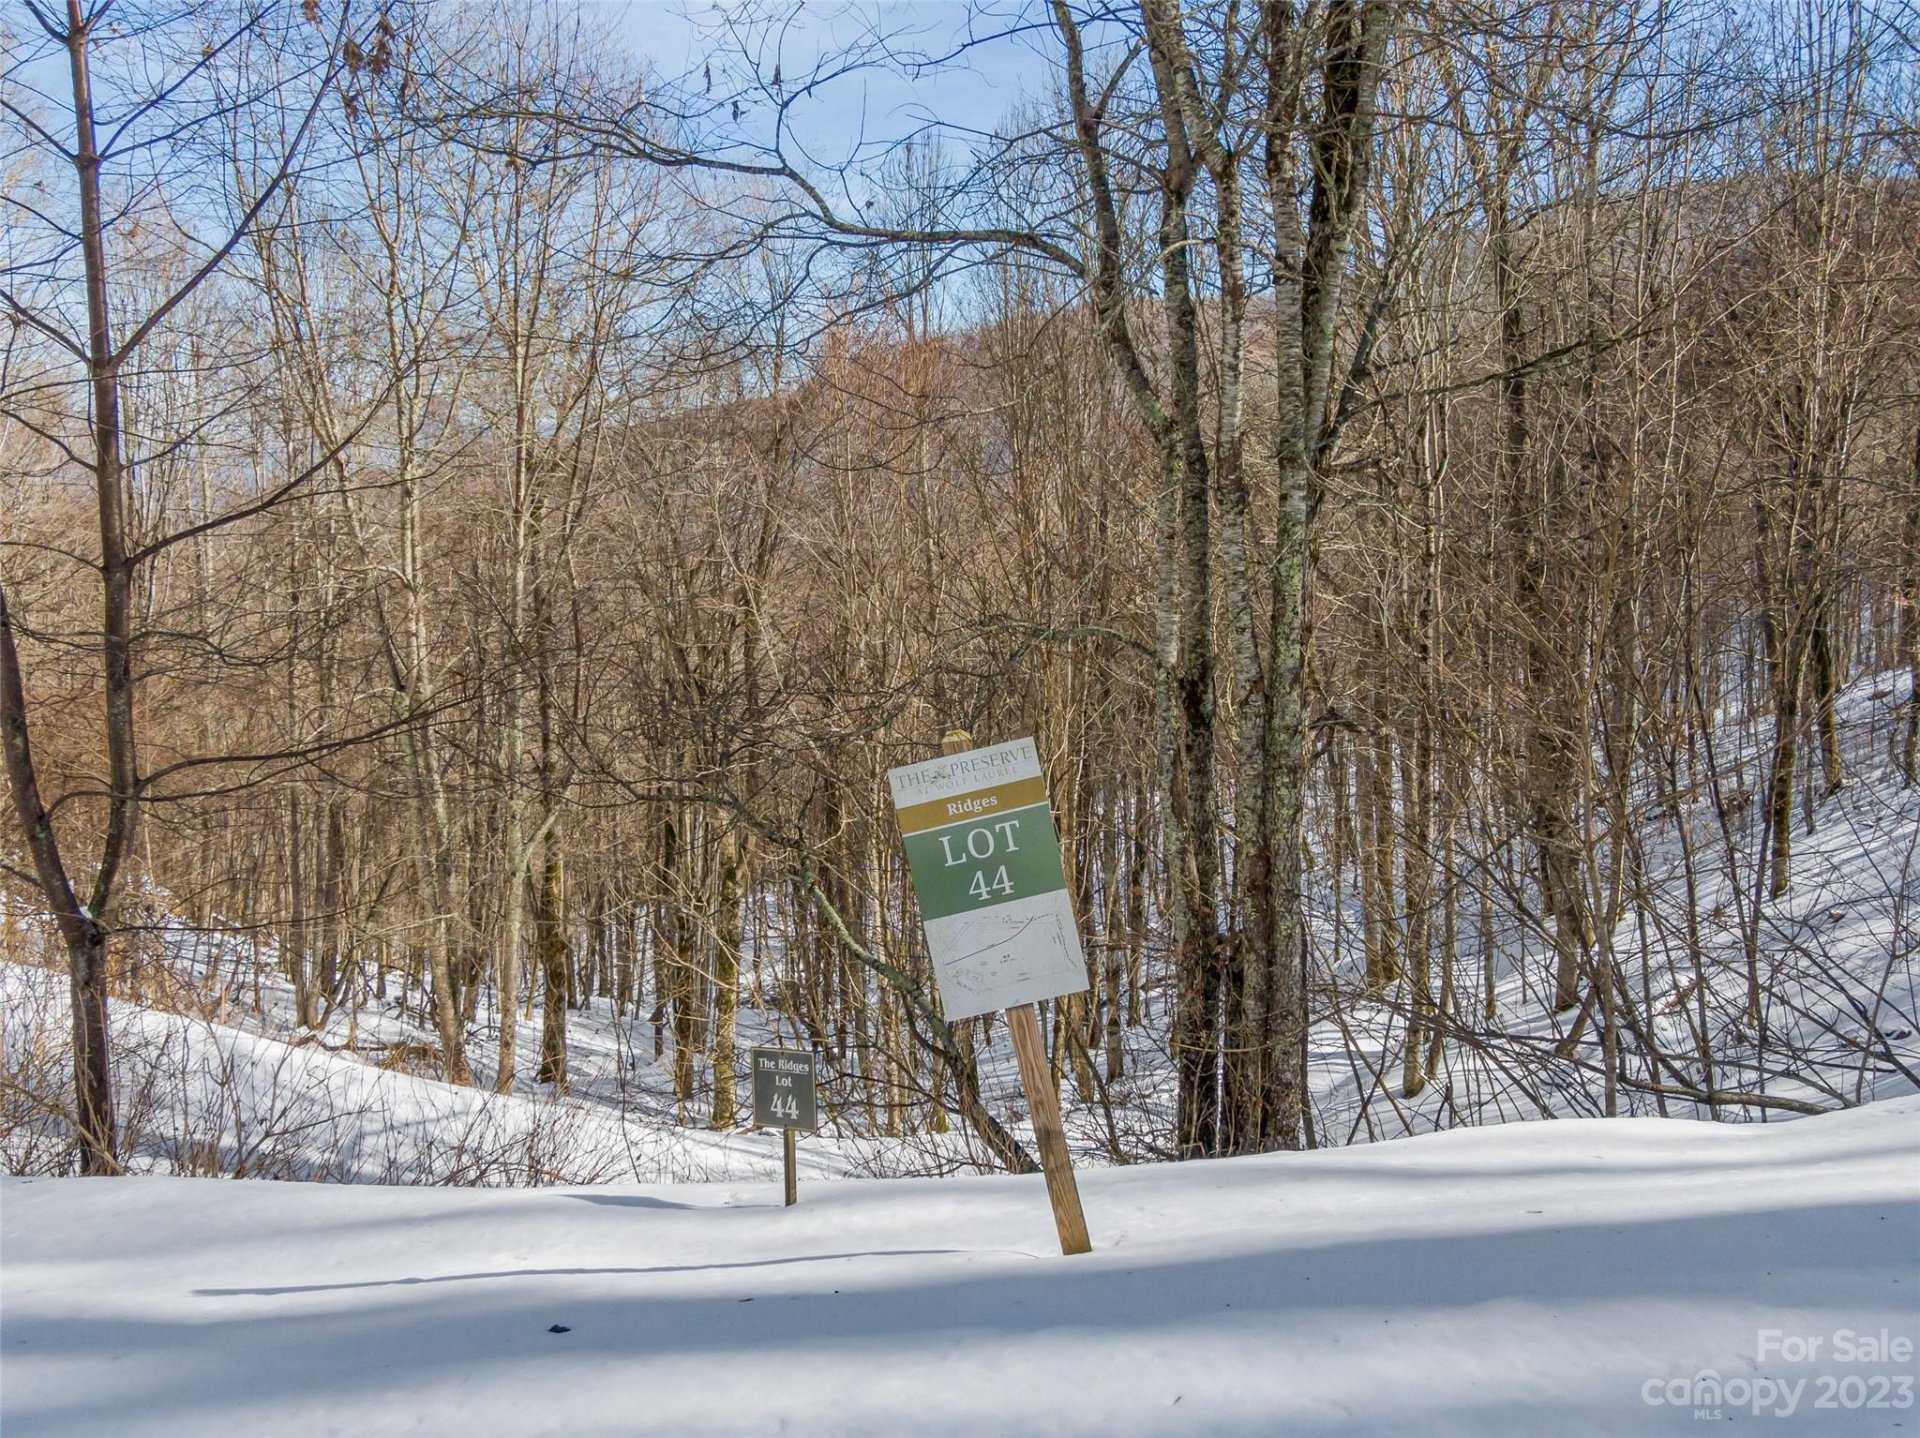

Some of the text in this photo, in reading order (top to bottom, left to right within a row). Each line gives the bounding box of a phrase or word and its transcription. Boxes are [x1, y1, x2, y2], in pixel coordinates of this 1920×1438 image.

[895, 746, 1033, 789] THE PRESERVE
[936, 777, 966, 791] WOLF
[974, 766, 1017, 783] LAUREL
[946, 795, 998, 816] Ridges
[939, 820, 1020, 866] LOT
[969, 865, 1014, 900] 44
[759, 1058, 809, 1072] The Ridges
[775, 1075, 792, 1087] Lot
[771, 1093, 799, 1120] 44
